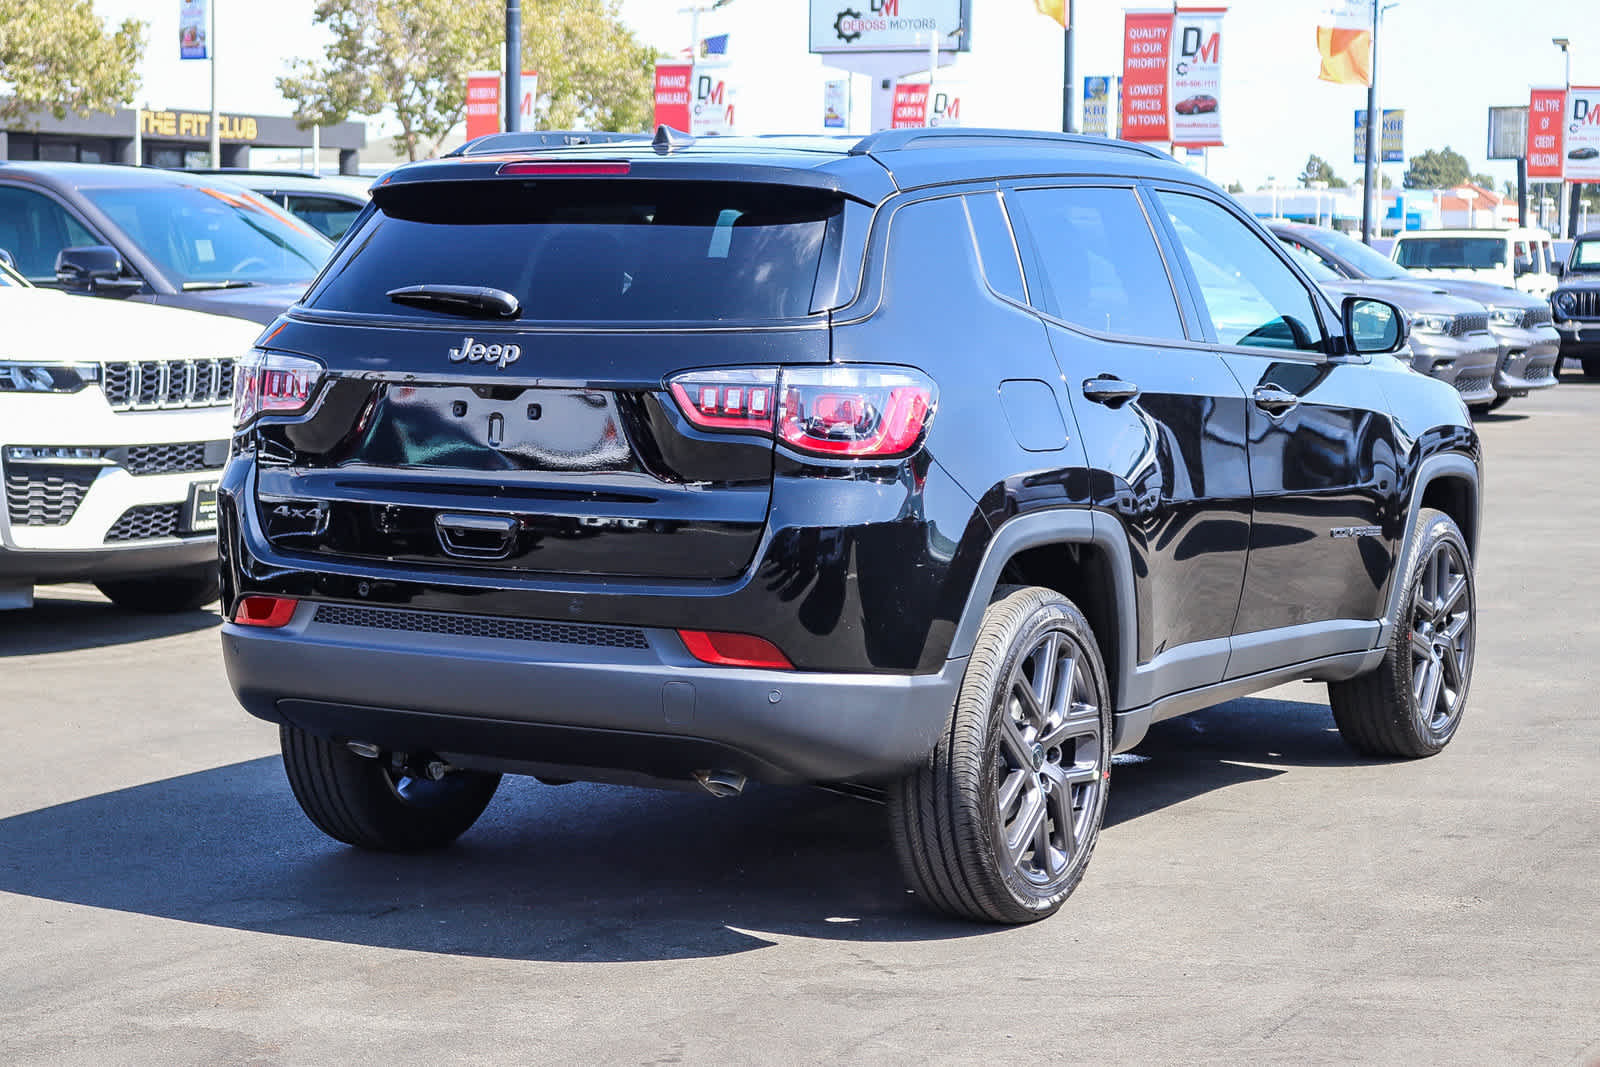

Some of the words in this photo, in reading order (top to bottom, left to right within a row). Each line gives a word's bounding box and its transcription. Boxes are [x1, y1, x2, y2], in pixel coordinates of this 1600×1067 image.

[890, 18, 936, 30] MOTORS
[1129, 27, 1168, 39] QUALITY
[1133, 43, 1141, 54] IS
[1143, 42, 1162, 54] OUR
[1127, 58, 1167, 69] PRIORITY
[660, 75, 686, 88] FINANCE
[1130, 84, 1164, 97] LOWEST
[911, 93, 926, 104] BUY
[1131, 99, 1162, 111] PRICES
[1534, 99, 1545, 112] ALL
[1546, 99, 1560, 112] TYPE
[141, 110, 177, 136] THE
[180, 113, 210, 137] FIT
[1128, 114, 1138, 125] IN
[1140, 114, 1166, 126] TOWN
[1541, 117, 1550, 130] OF
[1535, 135, 1556, 148] CREDIT
[1530, 153, 1559, 167] WELCOME
[448, 337, 521, 369] Jeep
[273, 505, 324, 520] 4x4
